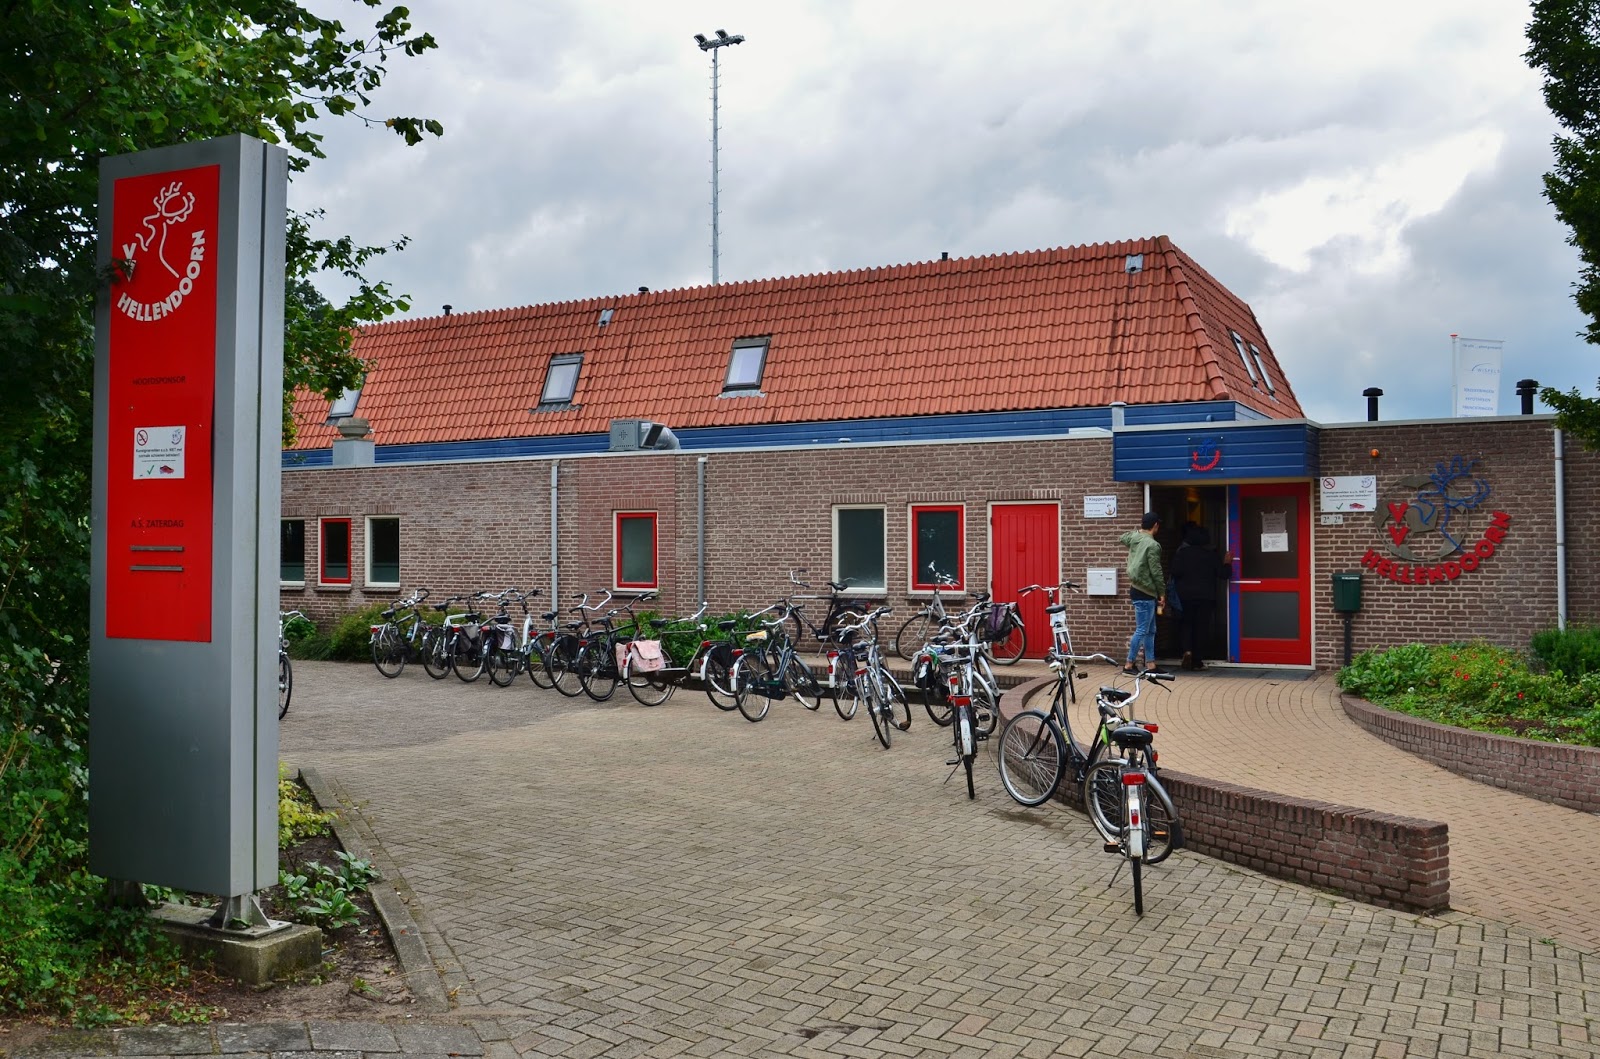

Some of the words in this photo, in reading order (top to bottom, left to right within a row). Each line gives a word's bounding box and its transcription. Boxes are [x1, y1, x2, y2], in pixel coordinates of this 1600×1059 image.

[117, 229, 206, 322] HELLENDOORN
[132, 375, 186, 386] HOOFDSPONSOR
[131, 519, 144, 528] A.S.
[146, 519, 184, 528] ZATERDAG
[1360, 510, 1512, 585] HELLENDOORN
